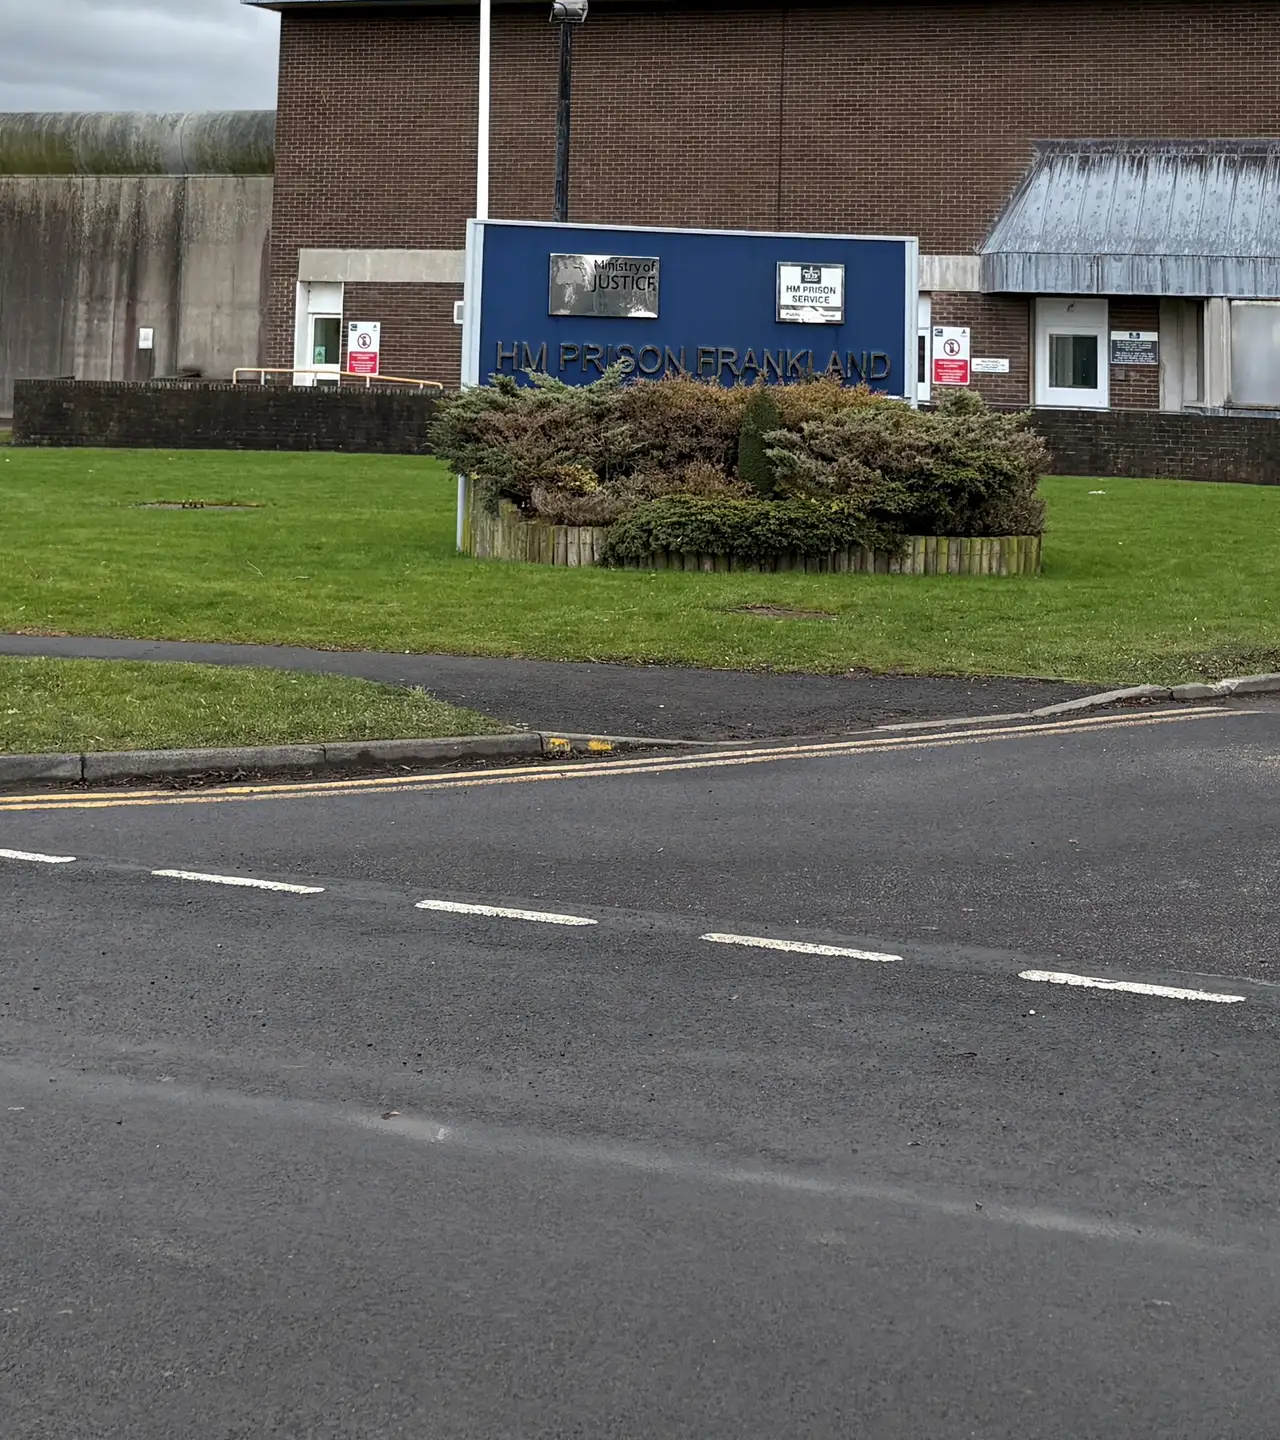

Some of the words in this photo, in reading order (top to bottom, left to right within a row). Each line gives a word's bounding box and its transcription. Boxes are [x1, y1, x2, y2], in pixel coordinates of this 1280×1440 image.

[594, 259, 641, 275] Ministry
[643, 261, 656, 272] of
[786, 285, 800, 293] HM
[803, 286, 836, 294] PRISON
[792, 295, 830, 304] SERVICE
[496, 340, 547, 371] HM
[560, 342, 686, 373] PRISON
[697, 346, 891, 379] FRANKLAND
